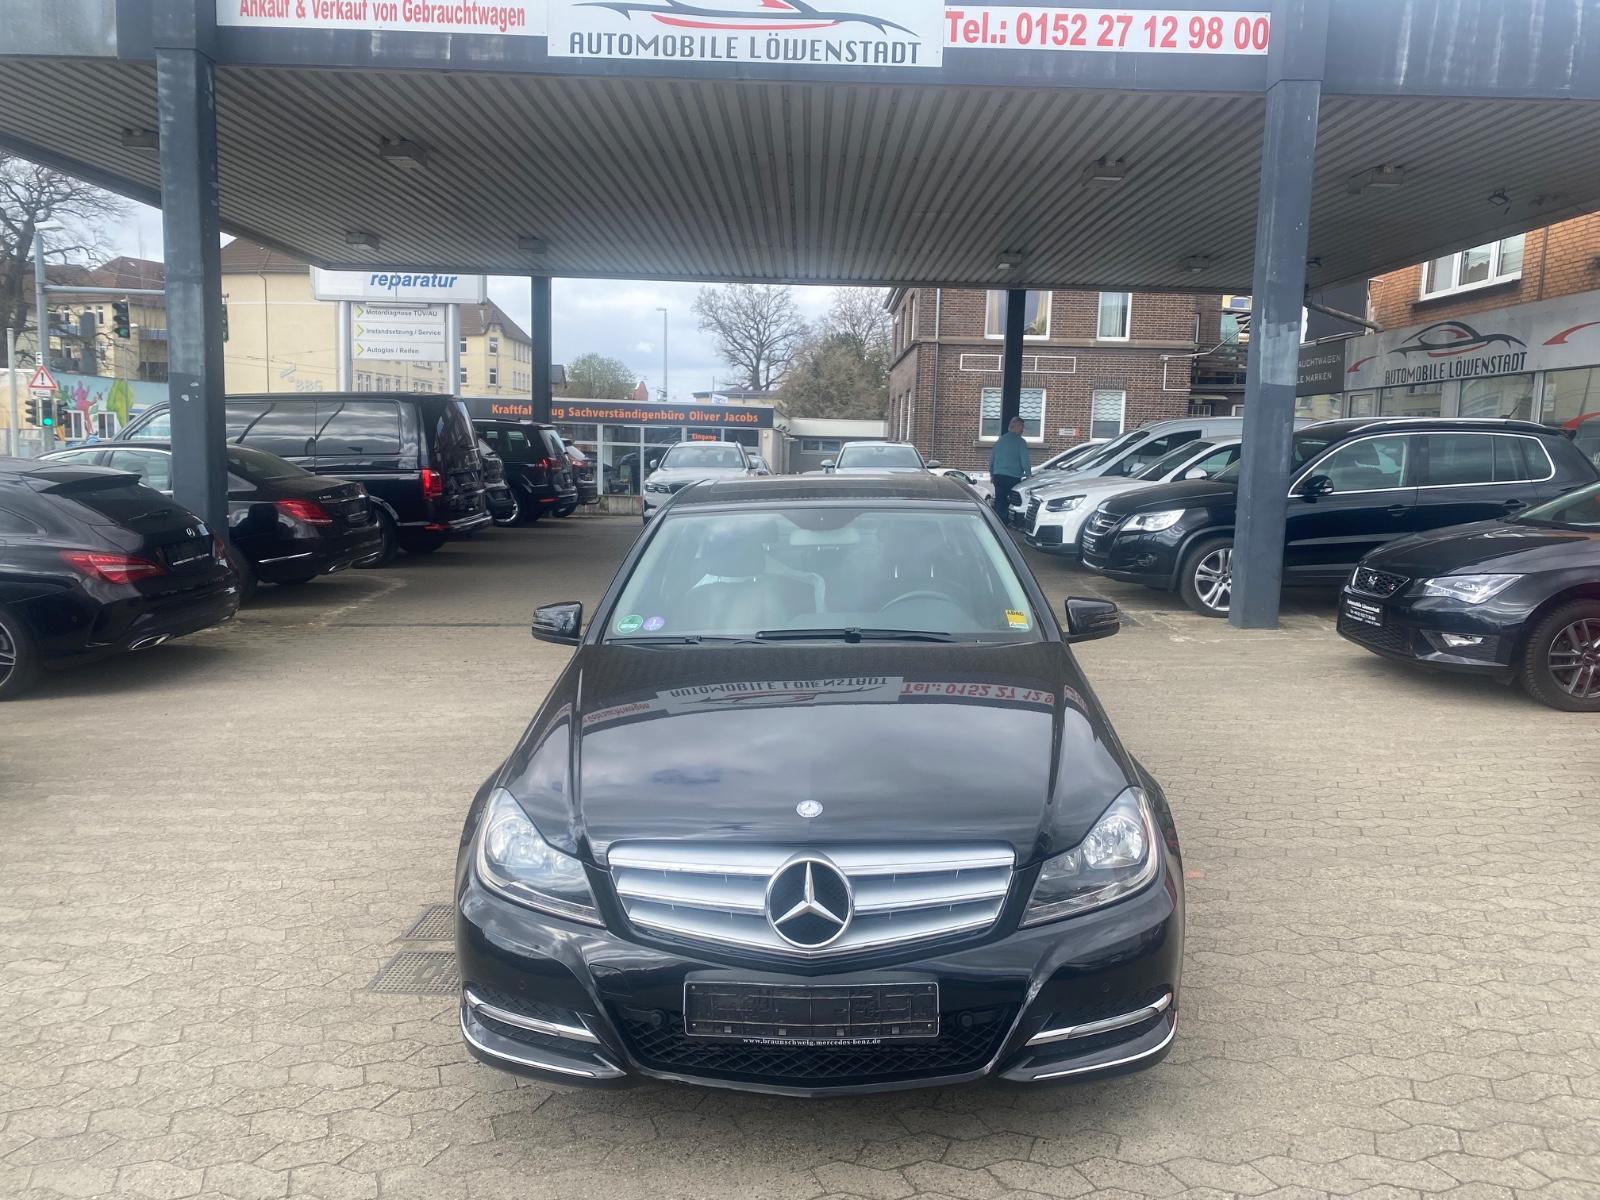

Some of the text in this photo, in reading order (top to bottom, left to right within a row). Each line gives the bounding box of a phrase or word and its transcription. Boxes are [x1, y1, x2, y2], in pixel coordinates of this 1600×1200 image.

[239, 0, 525, 32] Ankauf & Verkauf von Gebrauchtwagen
[945, 11, 1270, 50] Tel.: 0152 27 12 98 00
[569, 31, 922, 64] AUTOMOBILE LÖWENSTADT
[370, 272, 457, 290] reparatur
[366, 328, 413, 336] Instandsetzung
[1385, 351, 1528, 386] AUTOMOBILE LÖWENSTADT
[568, 406, 685, 421] Sachverständigenbüro
[689, 411, 720, 422] Oliver
[724, 412, 759, 423] Jacobs
[691, 432, 717, 442] Eingang
[742, 1037, 881, 1047] www.braunschweig.mercedes-benz.de
